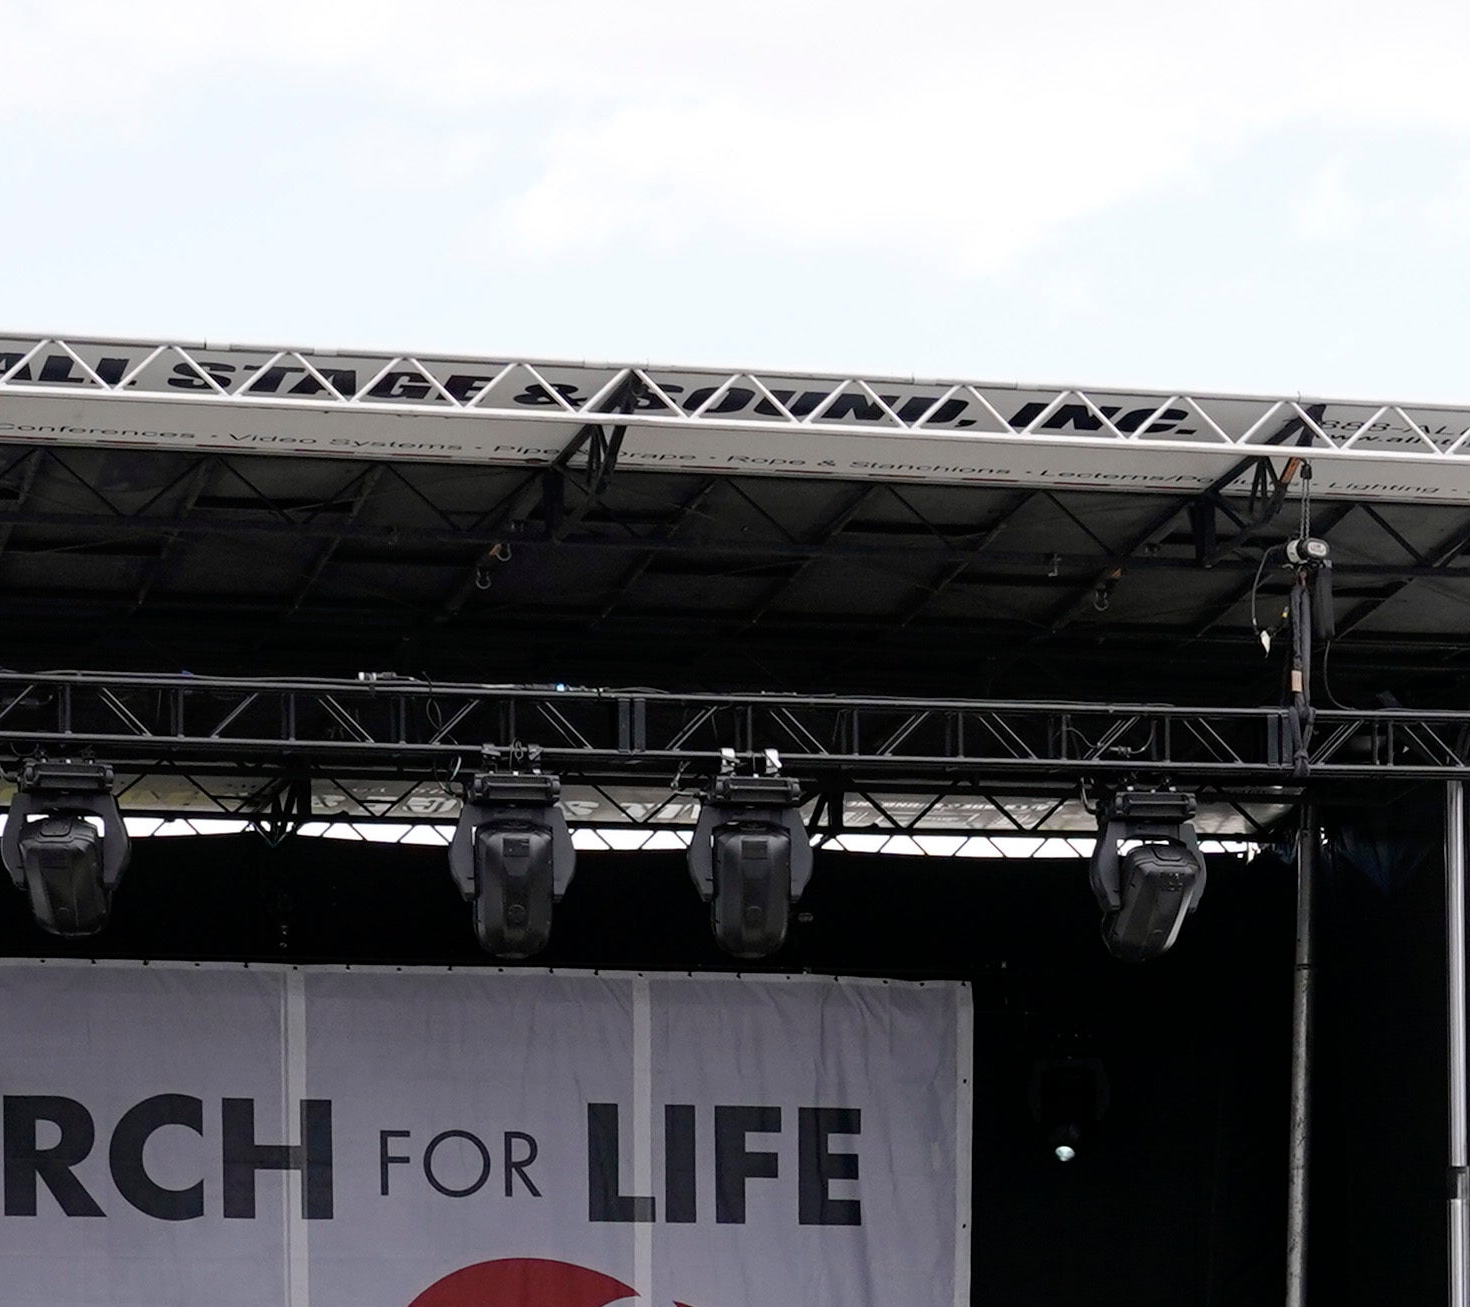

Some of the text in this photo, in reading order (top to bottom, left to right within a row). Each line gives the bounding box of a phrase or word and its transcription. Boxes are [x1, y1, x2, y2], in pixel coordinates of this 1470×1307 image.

[168, 361, 496, 402] STAGE
[1009, 402, 1197, 435] INC.
[229, 432, 316, 444] Video
[331, 438, 462, 454] Systems
[728, 456, 807, 469] Rope
[850, 461, 1012, 475] Stanchions
[380, 1128, 543, 1199] FOR
[587, 1102, 862, 1227] LIFE
